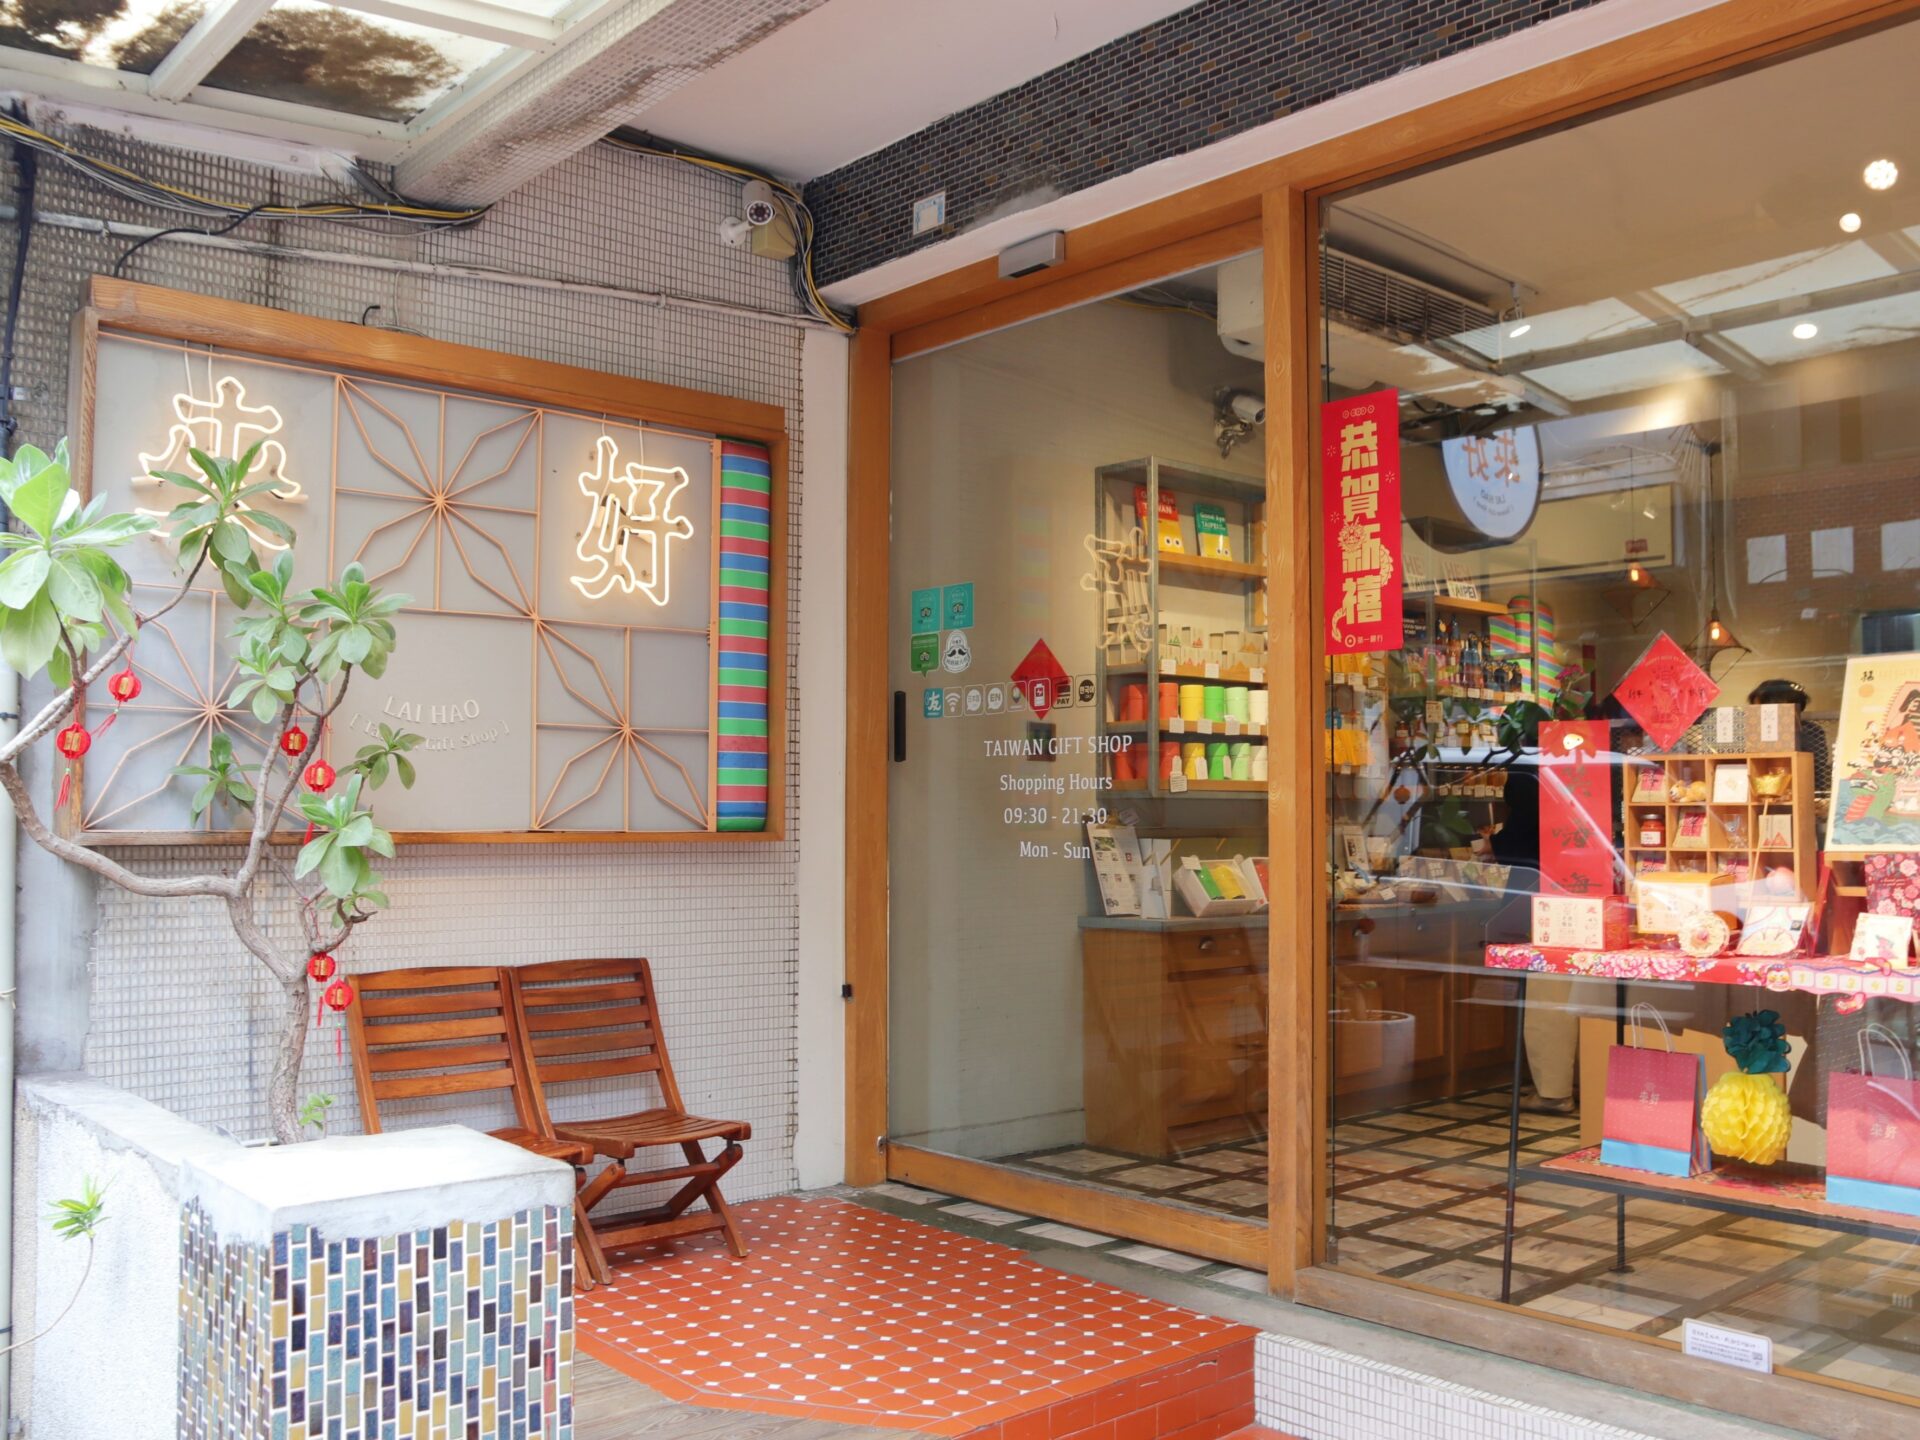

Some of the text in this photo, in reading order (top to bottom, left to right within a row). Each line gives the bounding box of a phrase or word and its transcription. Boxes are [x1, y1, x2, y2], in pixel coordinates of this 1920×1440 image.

[569, 435, 694, 607] 好
[1340, 419, 1383, 625] 恭賀新禧
[990, 693, 1001, 703] EN
[384, 696, 480, 724] LAI HAO
[425, 736, 456, 751] Gift
[461, 727, 498, 748] Shop
[984, 735, 1133, 757] TAIWAN GIFT SHOP
[1000, 773, 1113, 795] Shopping Hours
[1004, 807, 1047, 824] 09:30
[1062, 807, 1107, 824] 21:30
[1020, 841, 1048, 858] Mon
[1063, 842, 1091, 859] Sun
